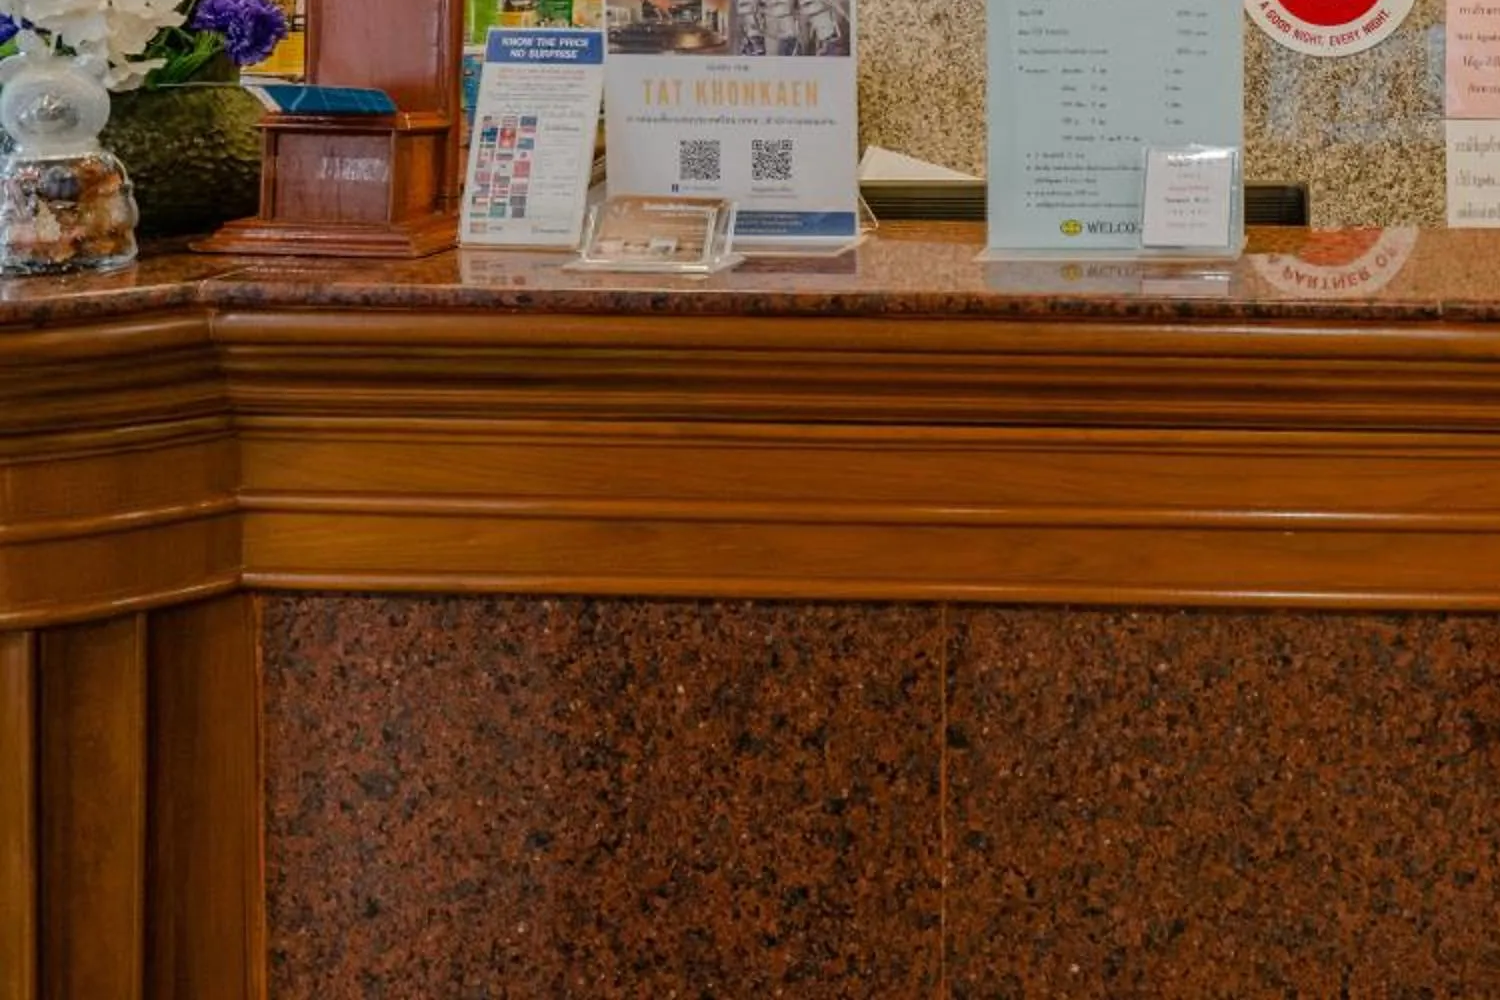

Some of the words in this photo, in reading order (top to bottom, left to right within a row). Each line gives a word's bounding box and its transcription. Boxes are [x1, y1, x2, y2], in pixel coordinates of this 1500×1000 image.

[1259, 0, 1270, 11] A
[1265, 10, 1292, 33] GOOD
[1329, 30, 1361, 47] EVERY
[502, 36, 533, 47] KNOW
[536, 36, 557, 48] THE
[509, 48, 527, 58] NO
[528, 48, 579, 60] SURPRISE
[643, 78, 682, 107] TAT
[1087, 221, 1143, 234] WELCO
